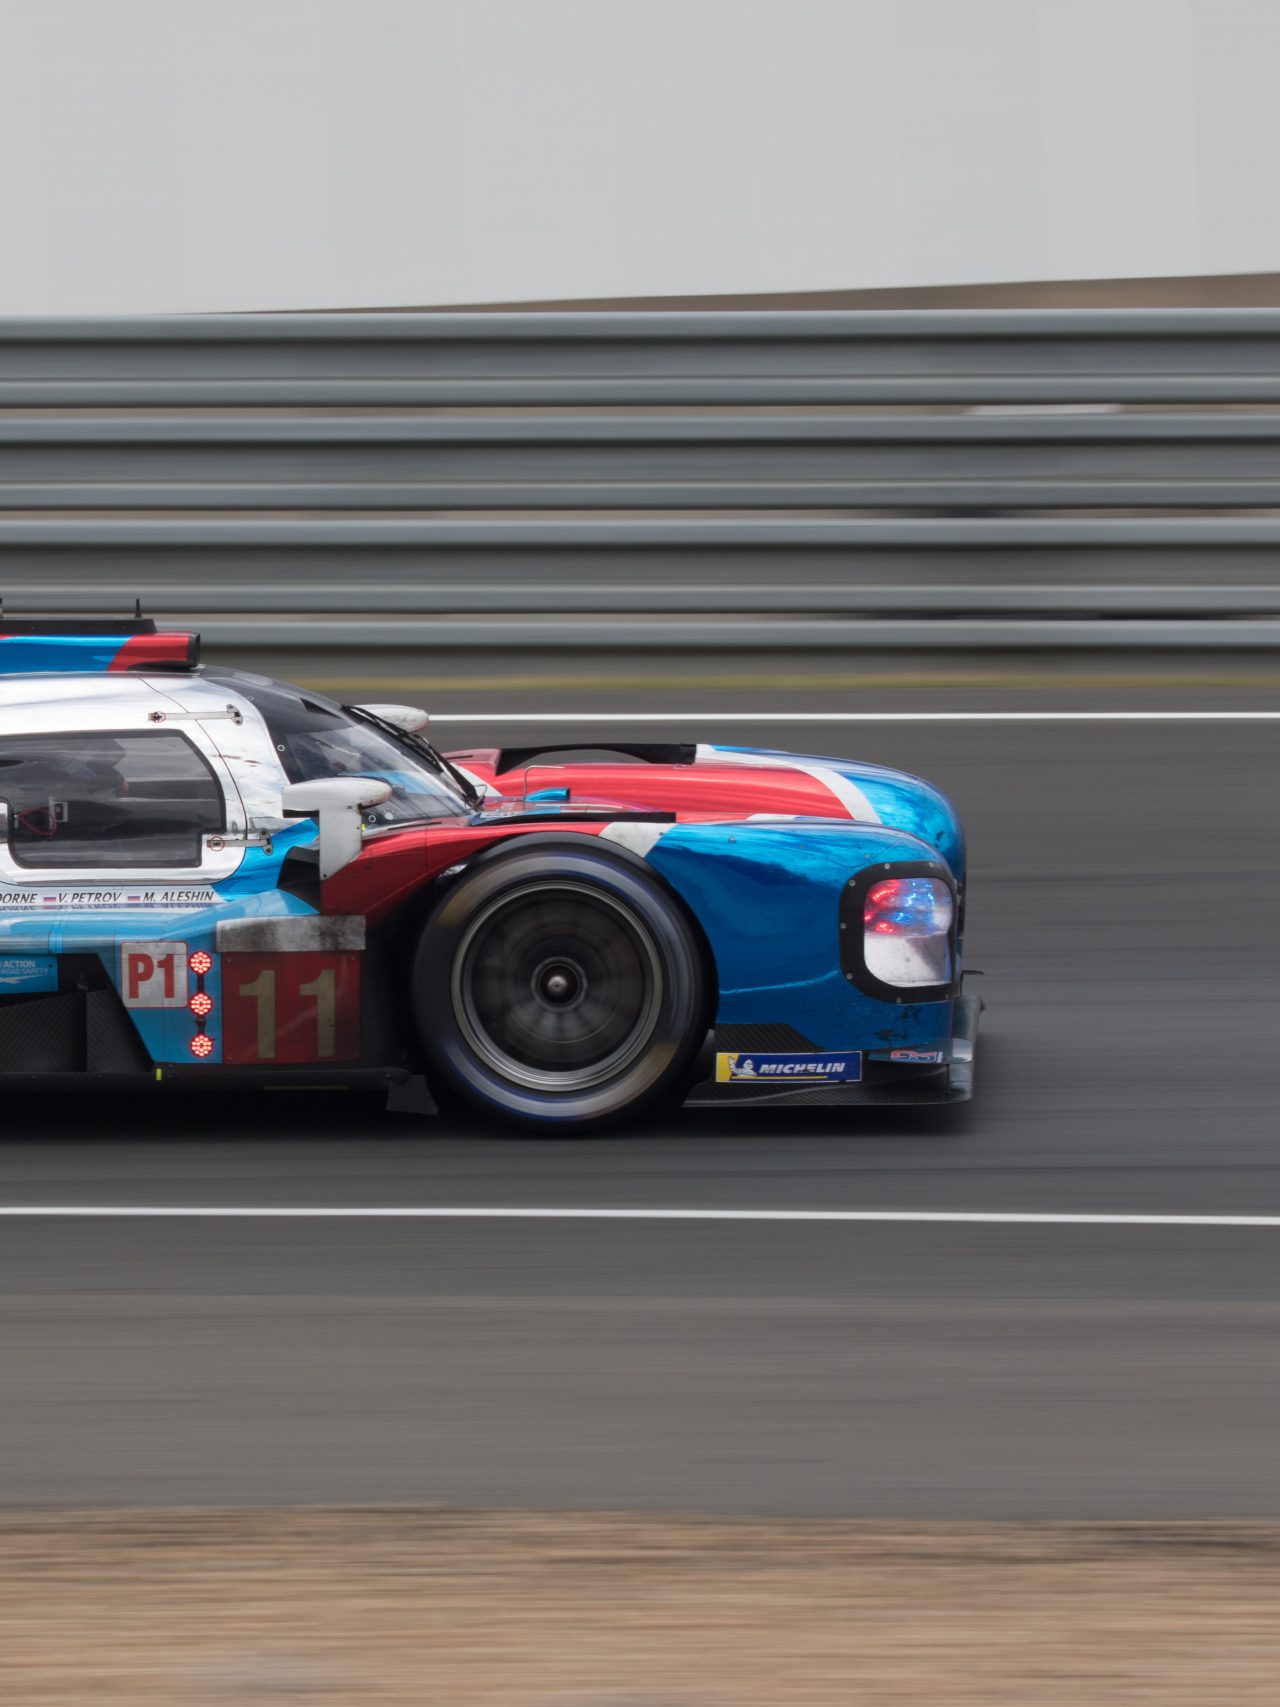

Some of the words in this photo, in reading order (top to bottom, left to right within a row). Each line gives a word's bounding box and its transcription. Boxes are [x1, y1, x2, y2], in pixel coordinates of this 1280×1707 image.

[71, 892, 122, 903] PETROV
[160, 891, 214, 902] ALESHIN
[3, 960, 36, 968] ACTION
[128, 953, 175, 999] P1
[239, 969, 336, 1059] 11
[759, 1062, 846, 1074] MICHELIN
